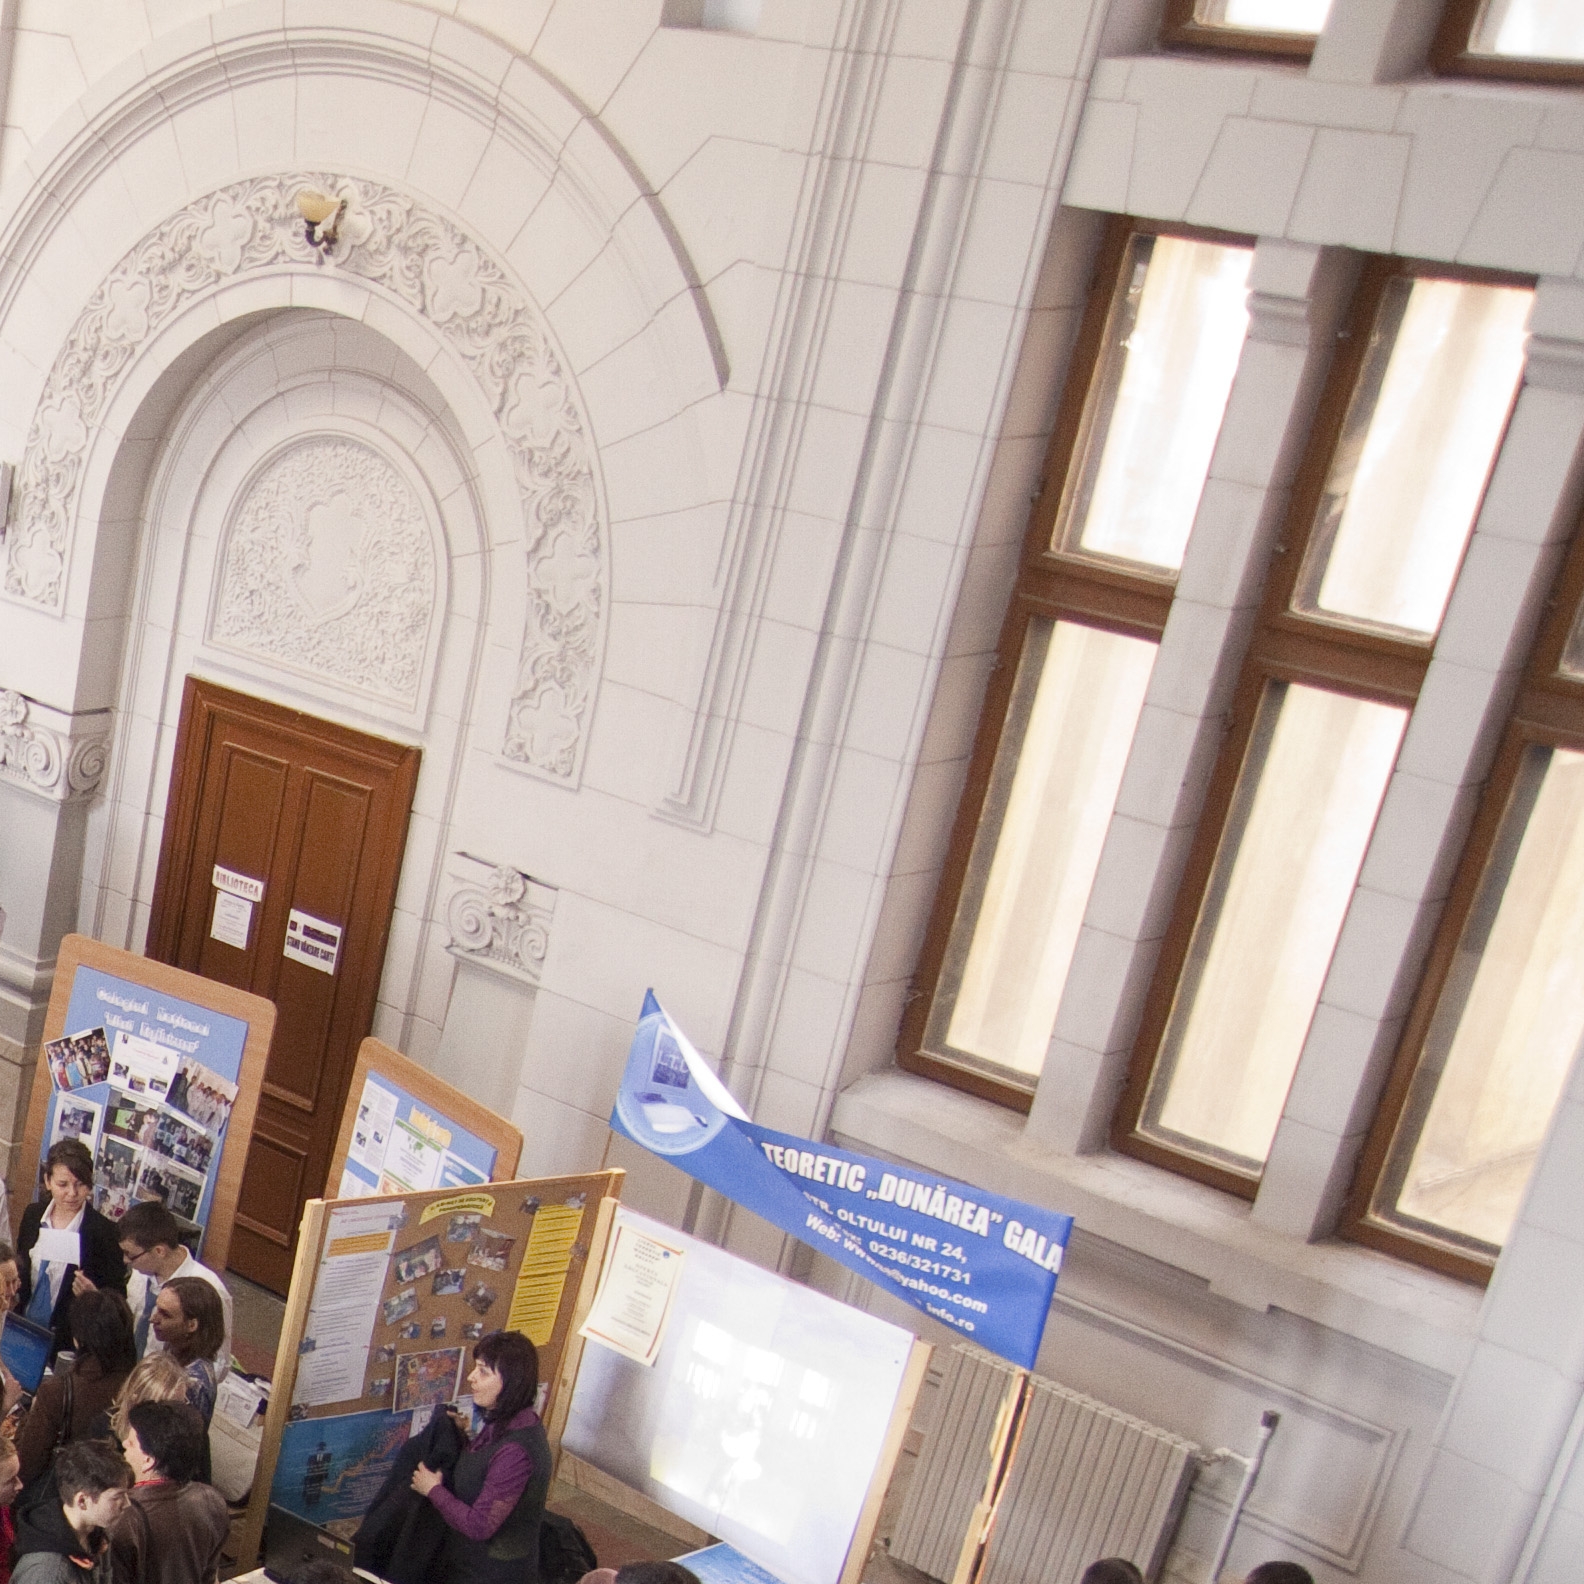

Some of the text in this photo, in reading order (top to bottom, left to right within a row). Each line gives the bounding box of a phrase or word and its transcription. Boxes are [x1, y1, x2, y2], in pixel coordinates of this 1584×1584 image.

[215, 871, 260, 898] BIBLIOTECA
[761, 1142, 866, 1193] TEORETIC
[837, 1208, 908, 1244] OLTULUI
[911, 1234, 937, 1254] NR
[868, 1240, 972, 1286] 0236/321731
